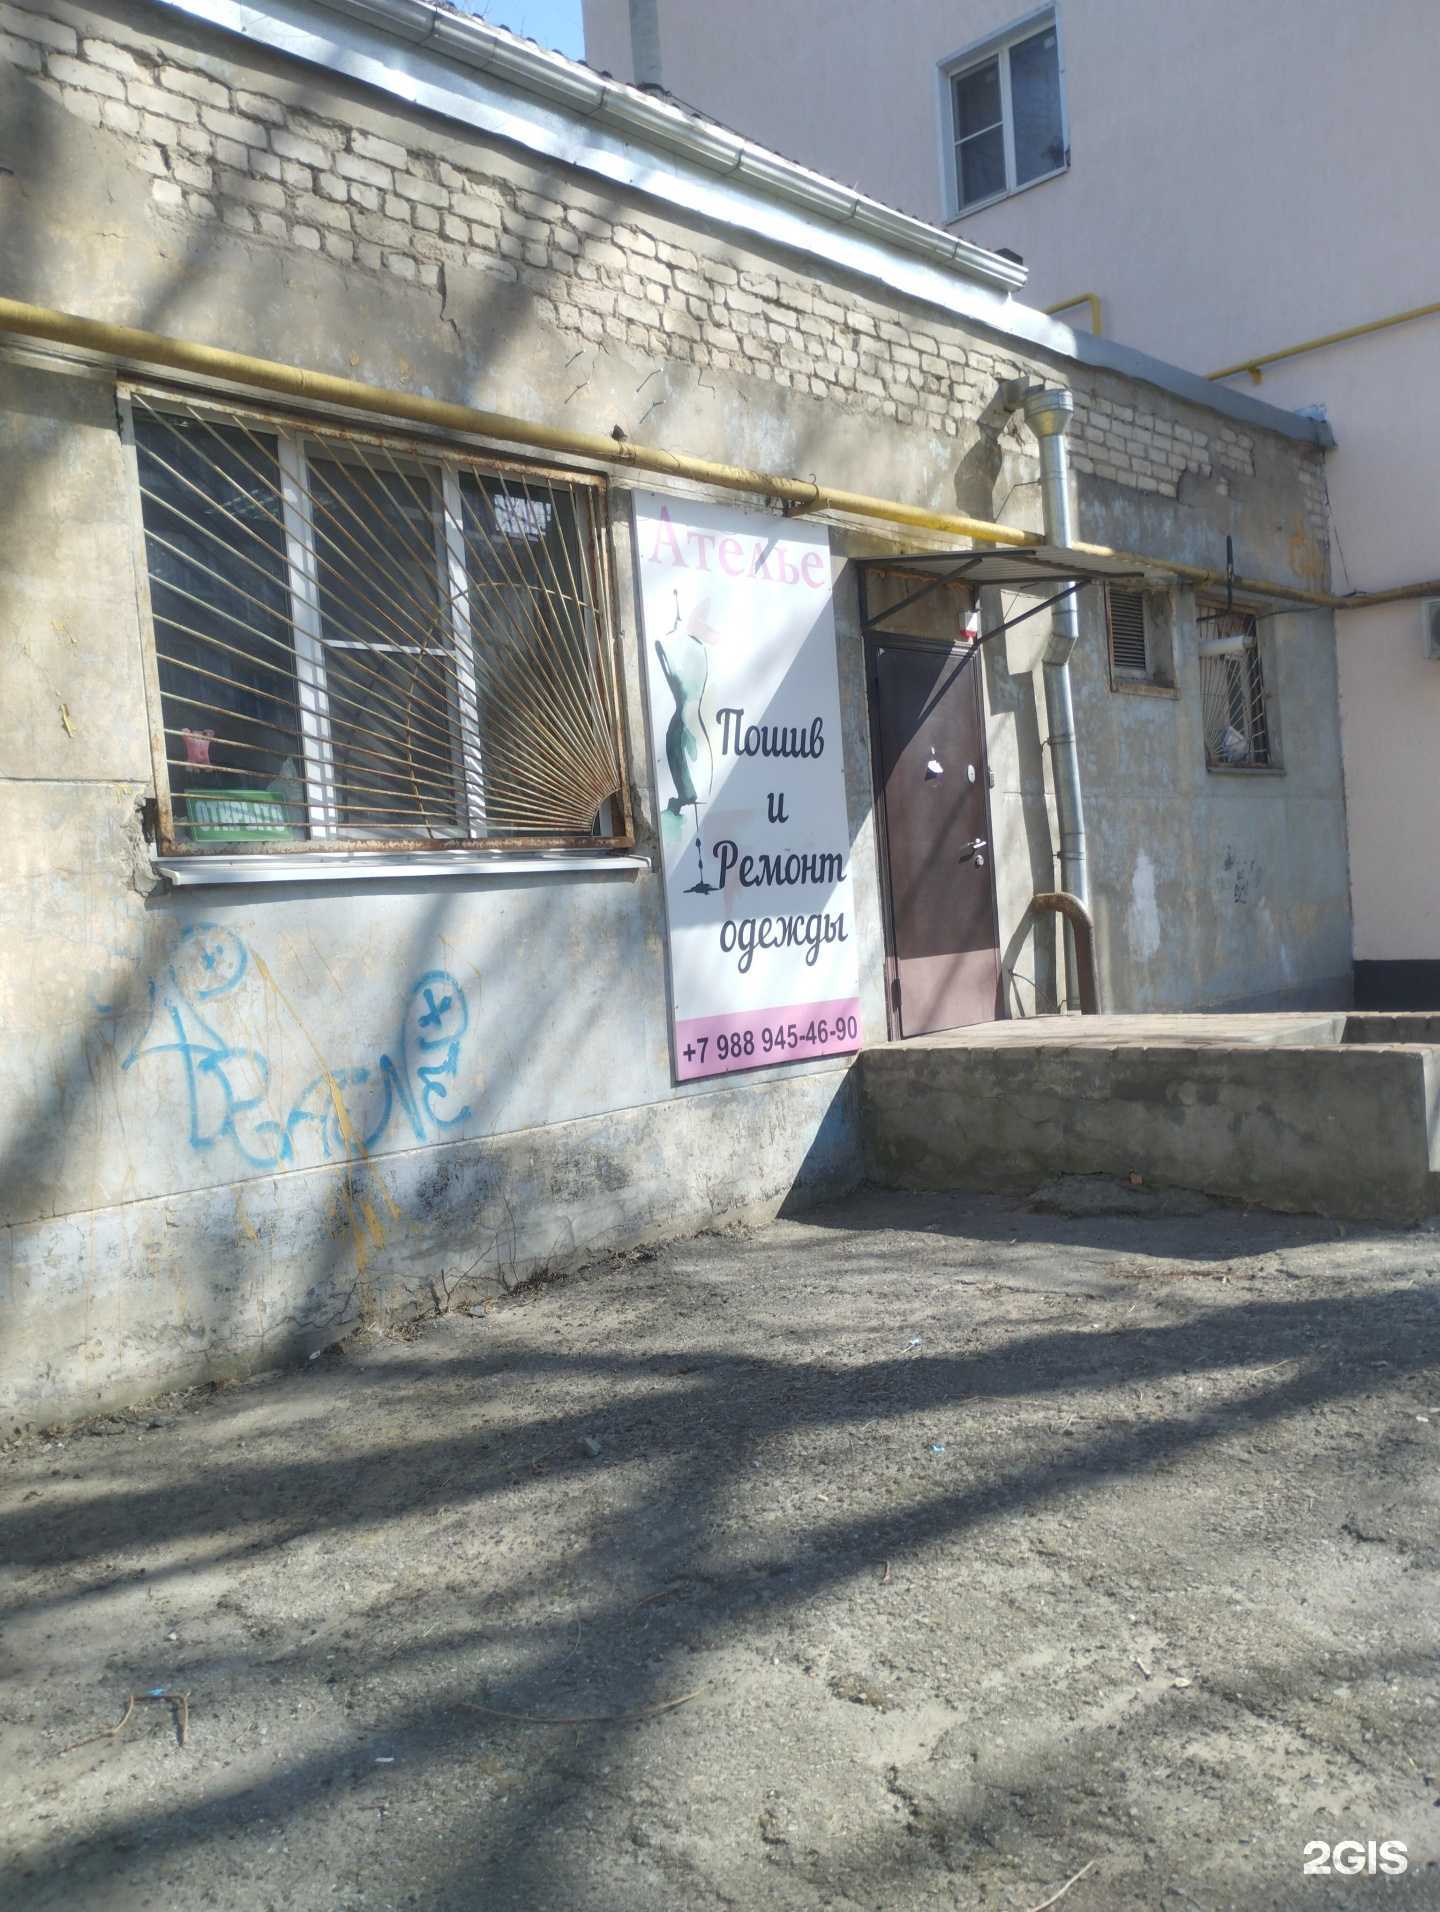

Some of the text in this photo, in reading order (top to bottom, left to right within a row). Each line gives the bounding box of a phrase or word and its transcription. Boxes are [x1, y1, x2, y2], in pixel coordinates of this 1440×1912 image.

[648, 504, 825, 589] Ателье
[716, 707, 825, 759] Пошив
[195, 800, 285, 832] ОТКРЫТО
[766, 792, 789, 823] и
[712, 839, 848, 889] Ремонт
[720, 912, 848, 974] одежды
[683, 1015, 858, 1064] +7 988 945-46-90
